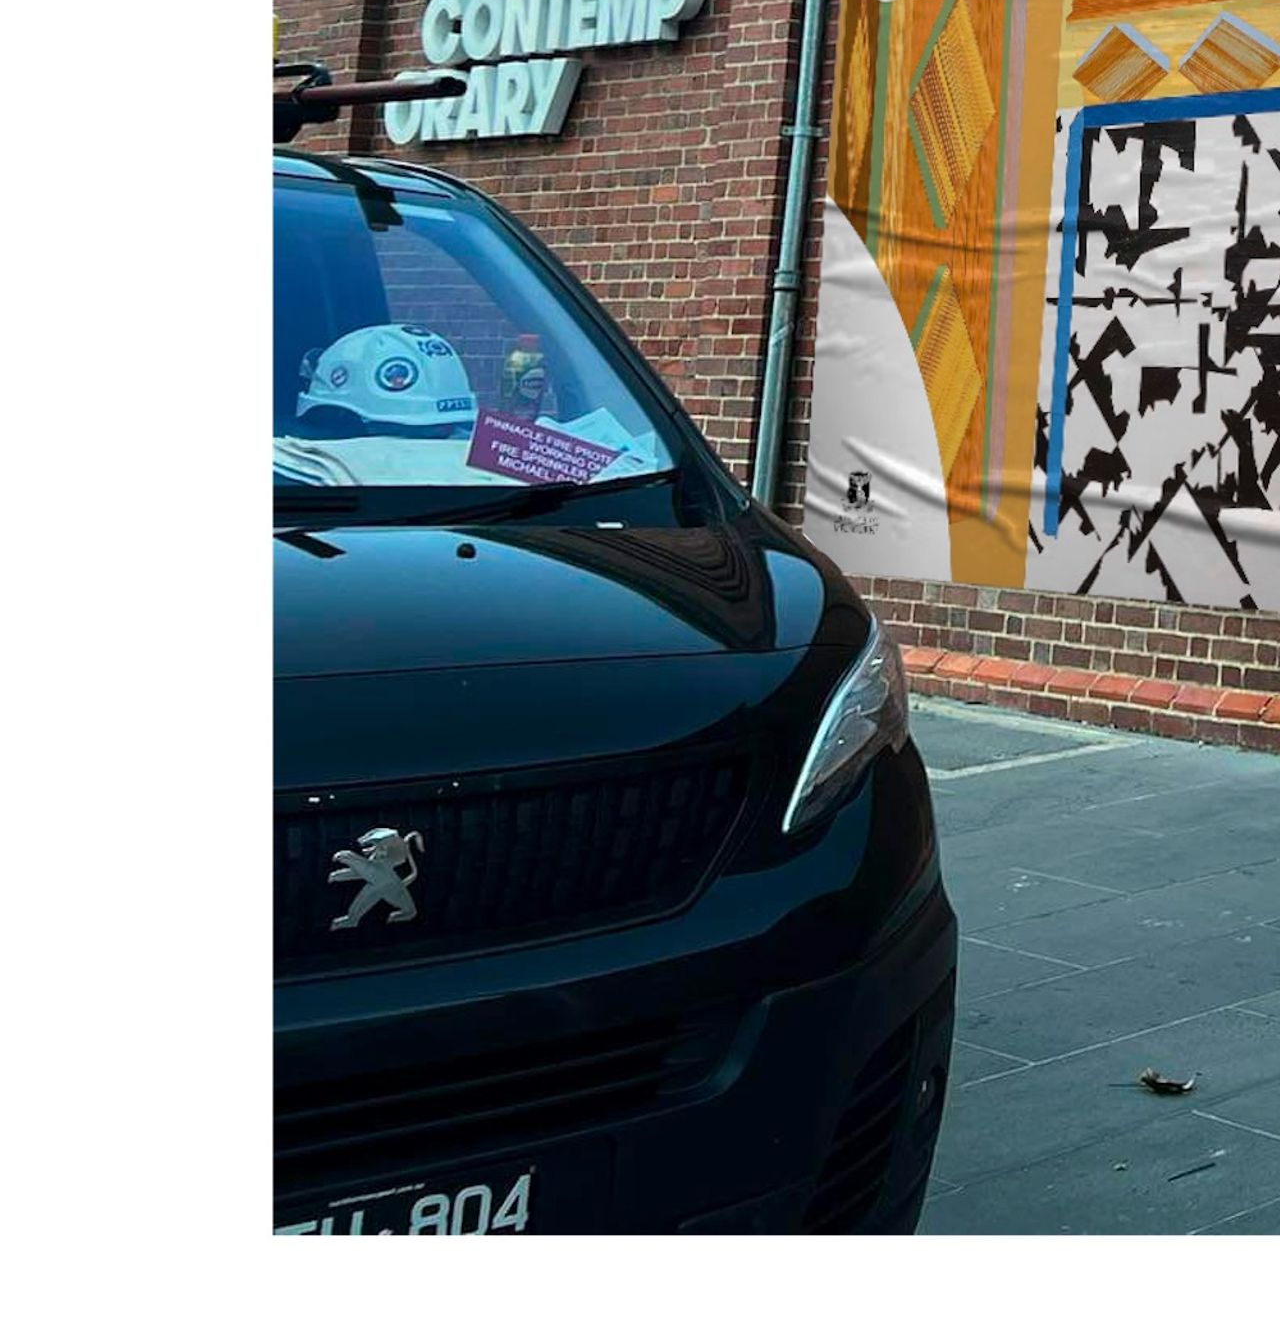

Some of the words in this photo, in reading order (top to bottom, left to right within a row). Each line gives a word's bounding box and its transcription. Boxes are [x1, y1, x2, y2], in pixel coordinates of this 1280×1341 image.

[485, 416, 544, 443] PINNACLE
[491, 440, 520, 458] FIRE
[521, 450, 588, 480] SPRINKLER
[529, 441, 587, 468] WORKING
